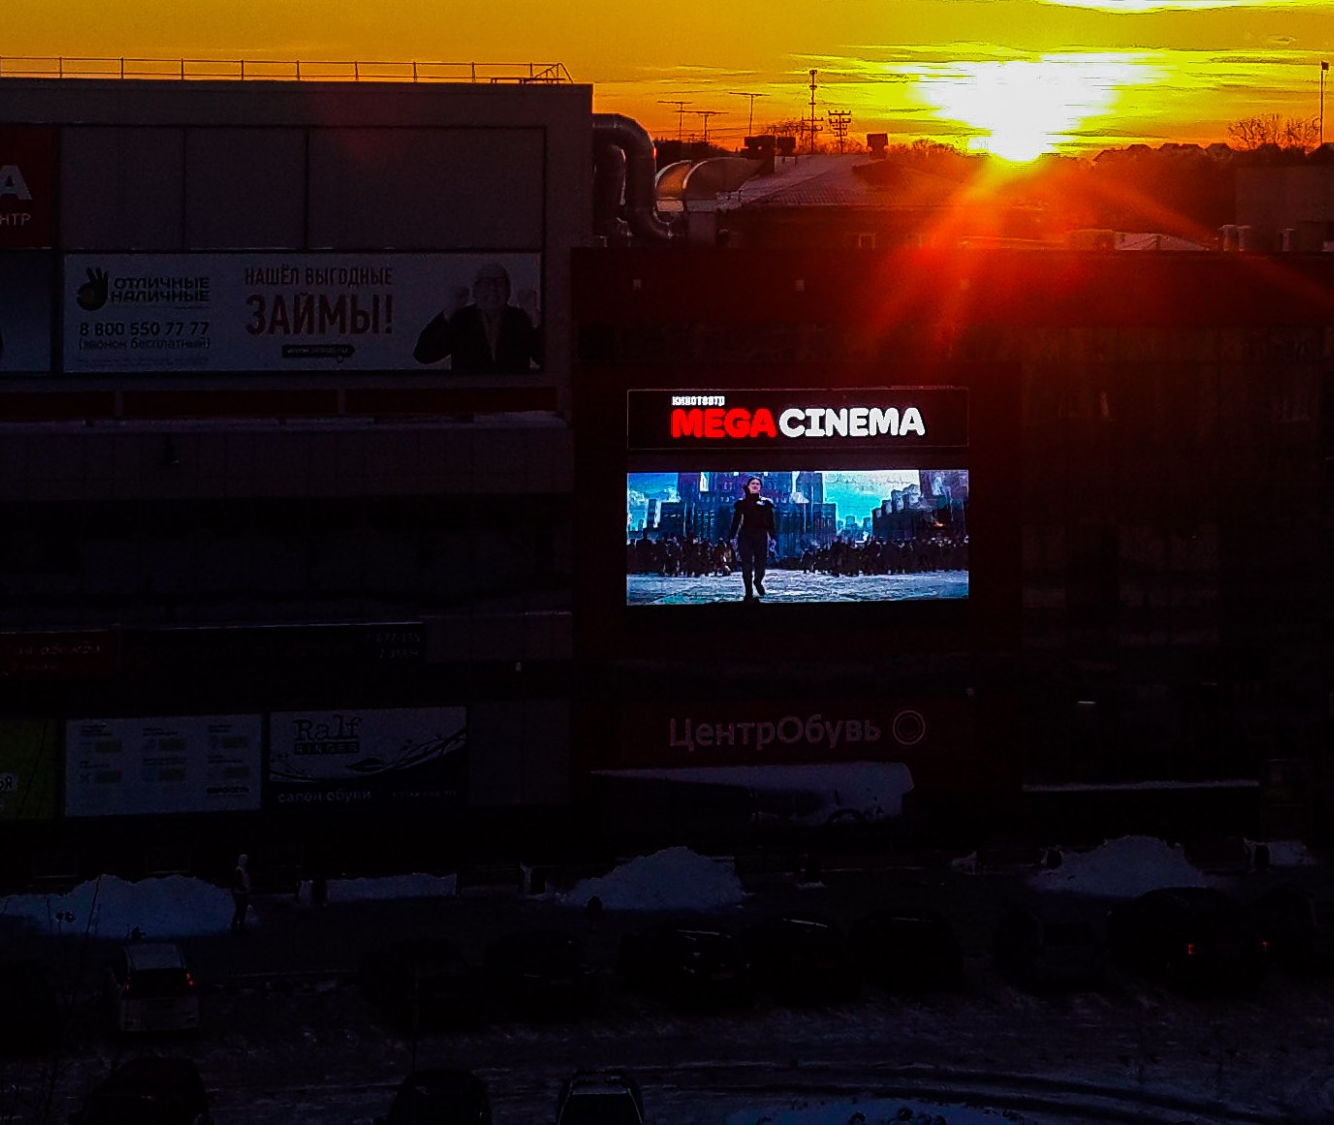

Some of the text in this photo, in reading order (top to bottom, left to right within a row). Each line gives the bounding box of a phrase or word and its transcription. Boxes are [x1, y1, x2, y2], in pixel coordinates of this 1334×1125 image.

[114, 277, 209, 289] ОТЛИЧНЫЕ
[305, 268, 393, 288] ВЫГОДНЫЕ
[110, 291, 209, 303] НАЛИЧНЫЕ
[245, 292, 393, 335] ЗАЙМЫ!
[79, 322, 210, 335] 8 800 550 77 77
[671, 407, 926, 438] MEGA CINEMA
[293, 715, 363, 741] Ralf
[669, 714, 882, 751] ЦентрОбувь
[277, 789, 372, 803] салон обуви
